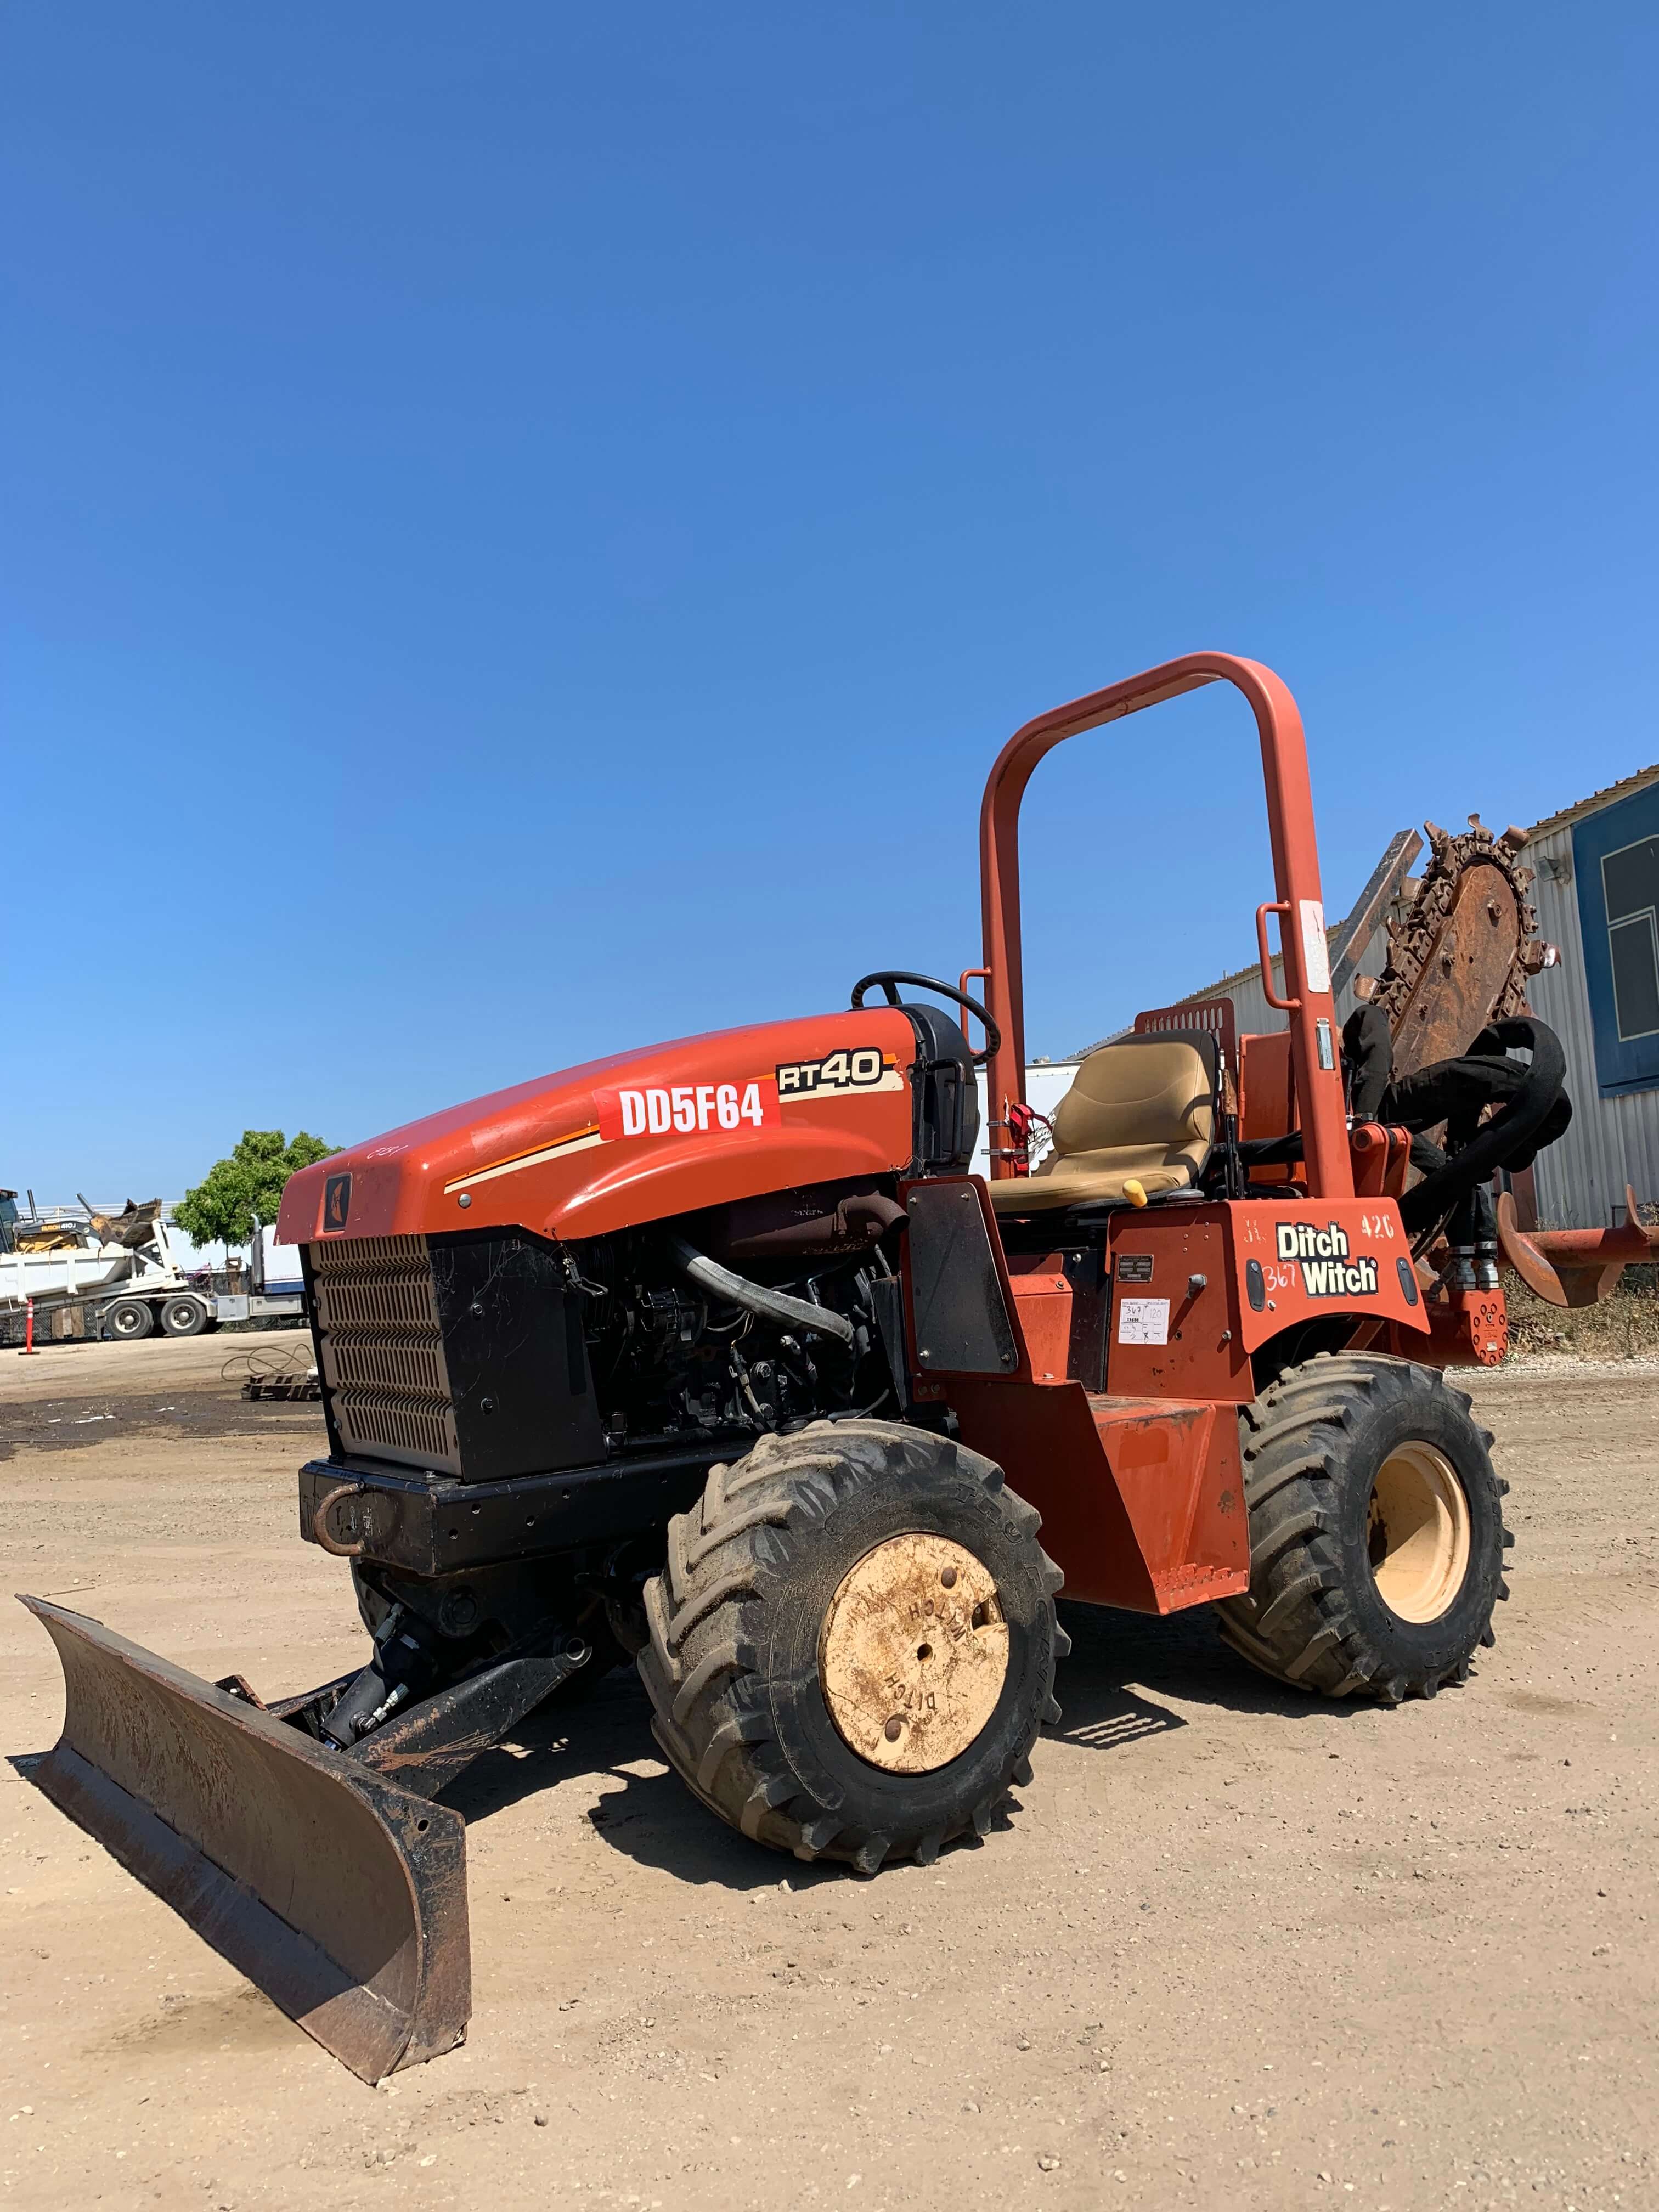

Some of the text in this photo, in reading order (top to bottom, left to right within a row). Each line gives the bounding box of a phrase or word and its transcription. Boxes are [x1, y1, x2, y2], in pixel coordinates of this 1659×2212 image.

[779, 1051, 880, 1090] RT40
[619, 1084, 764, 1136] DD5F64
[1277, 1224, 1348, 1257] Ditch
[1262, 1263, 1295, 1292] 367
[953, 1482, 1023, 1545] TRU
[884, 1598, 967, 1711] DITCH WITCH
